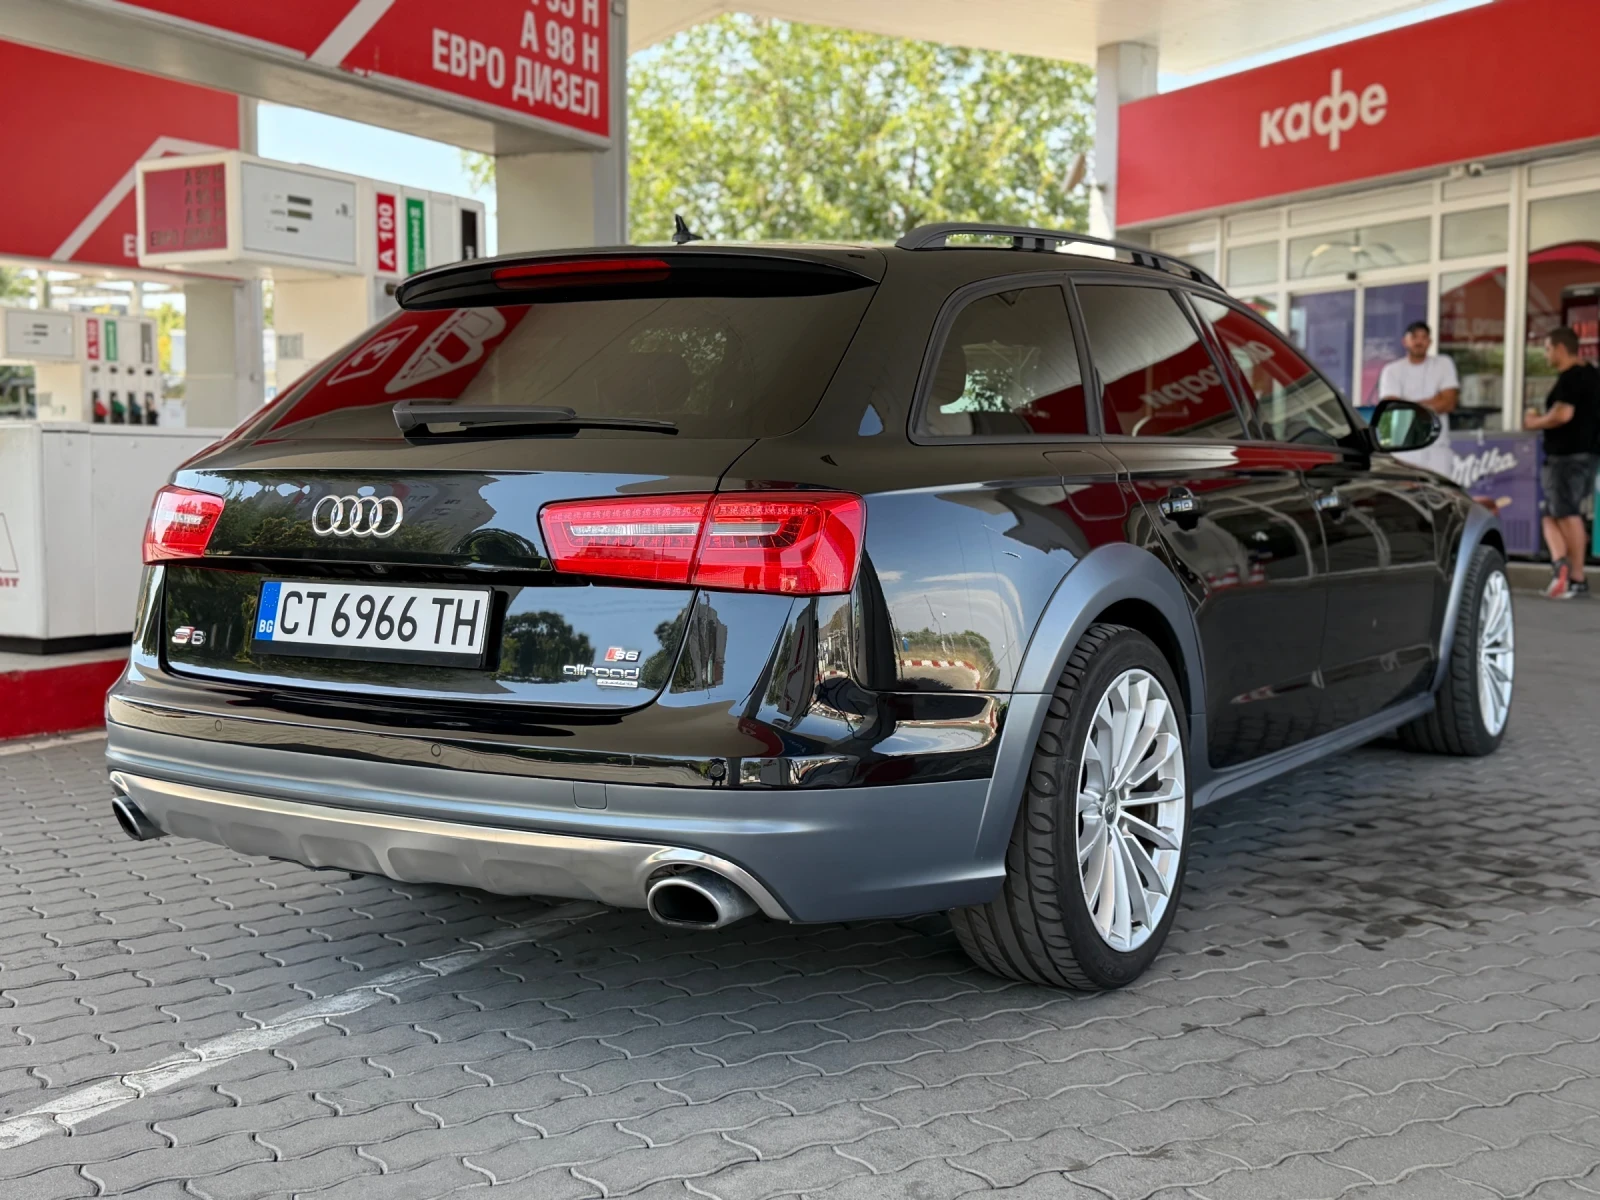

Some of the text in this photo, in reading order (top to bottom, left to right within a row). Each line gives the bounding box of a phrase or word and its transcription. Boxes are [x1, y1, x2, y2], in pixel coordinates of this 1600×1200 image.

[545, 20, 575, 65] 98
[432, 27, 599, 119] ЕВРО ДИЗЕЛ
[1259, 68, 1388, 151] кафе
[378, 203, 394, 242] 100
[1452, 447, 1517, 488] Milka
[172, 626, 206, 645] S6
[258, 619, 274, 634] BG
[280, 590, 481, 646] CT 6966 TH
[563, 664, 640, 679] allroad
[609, 648, 640, 661] S6
